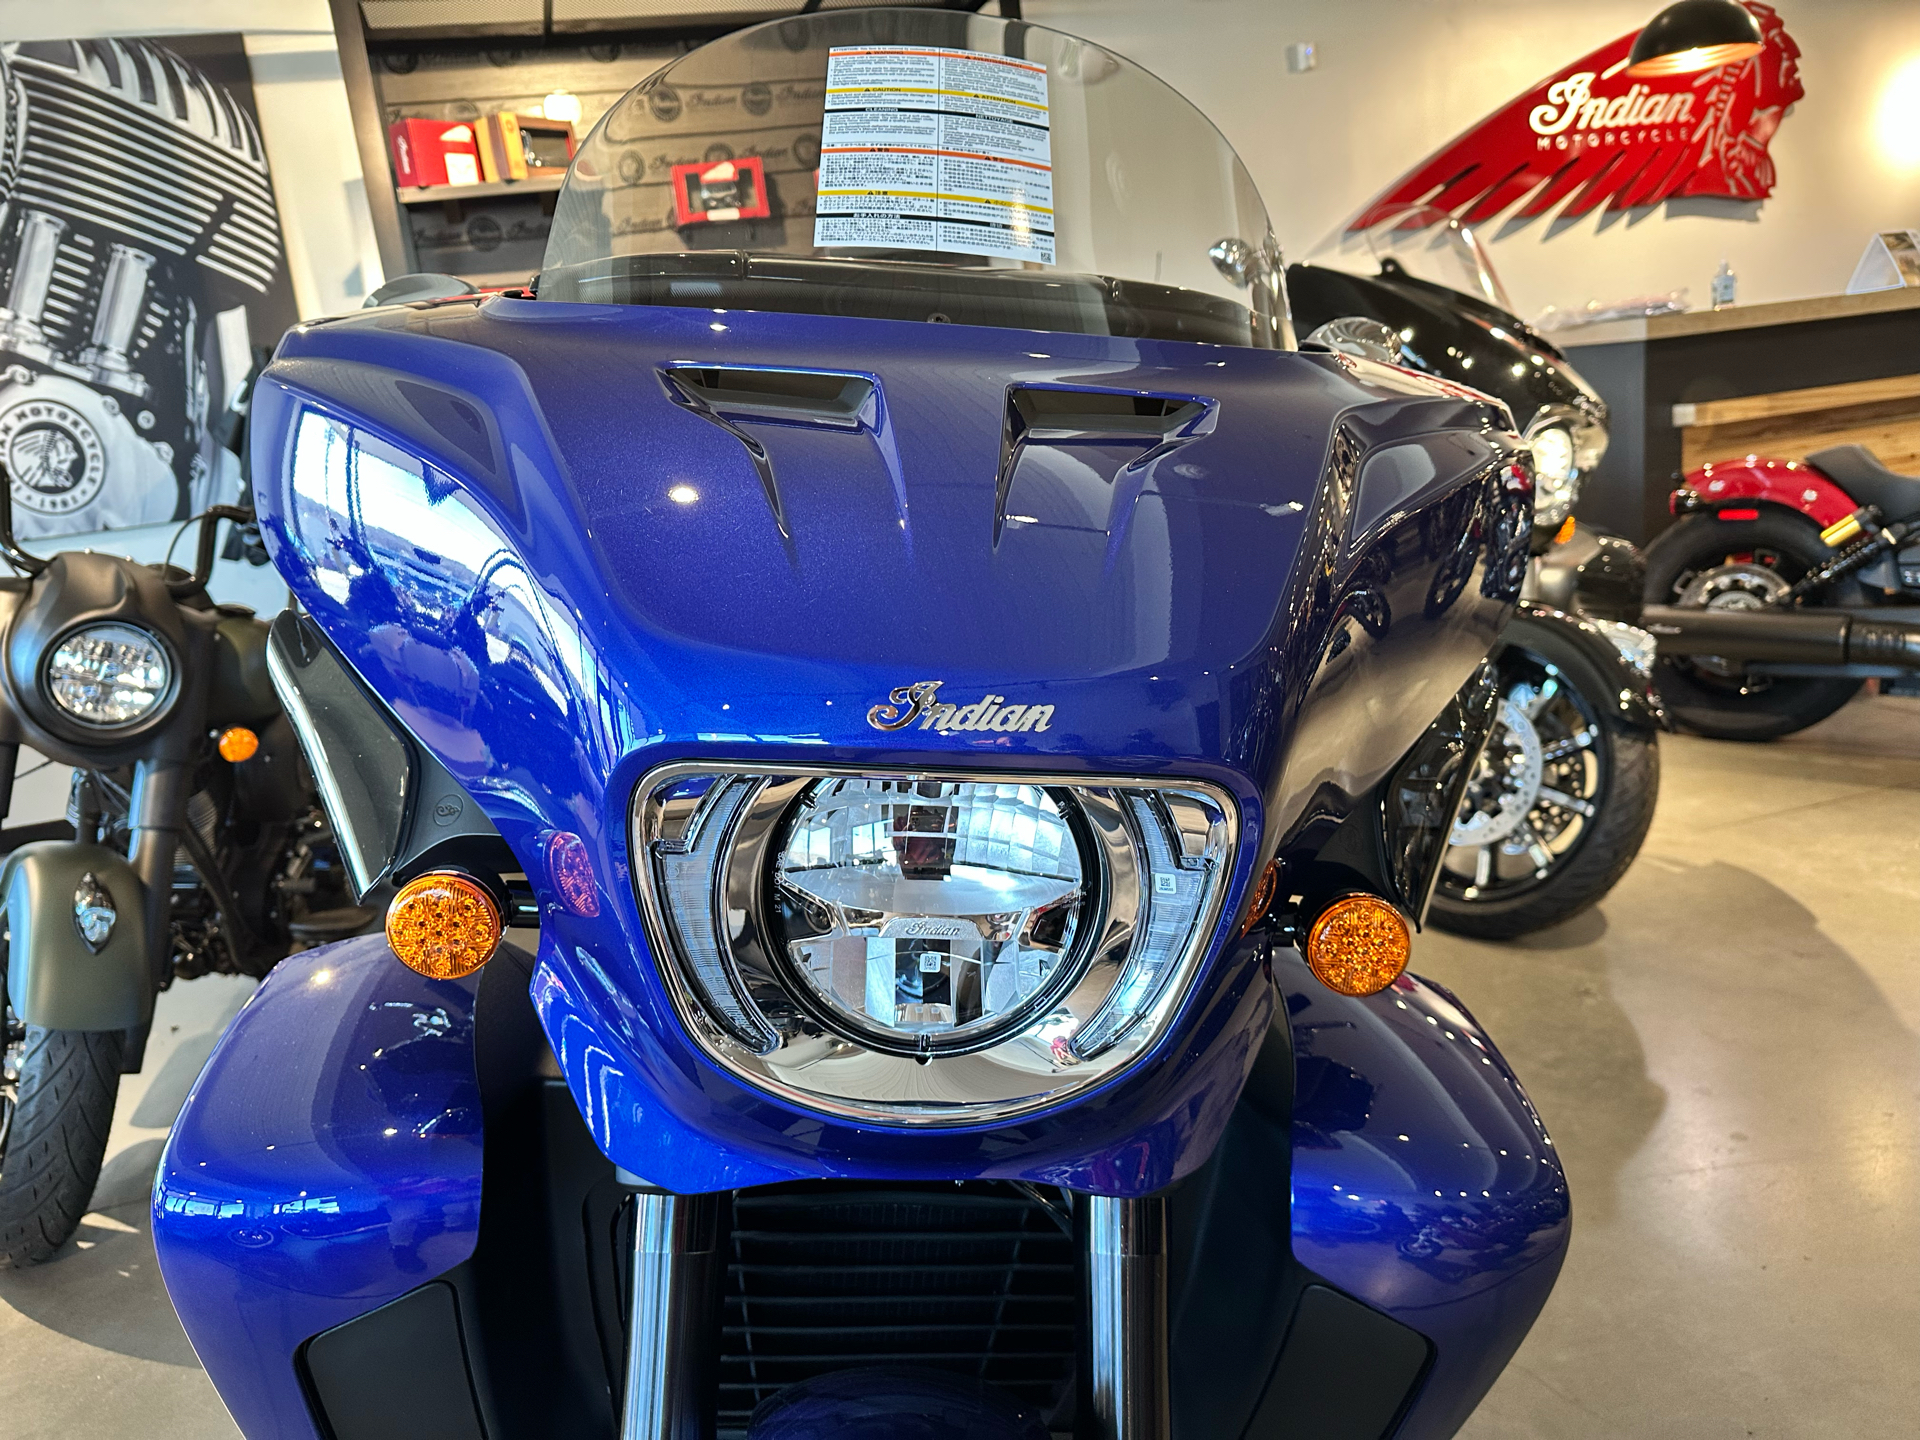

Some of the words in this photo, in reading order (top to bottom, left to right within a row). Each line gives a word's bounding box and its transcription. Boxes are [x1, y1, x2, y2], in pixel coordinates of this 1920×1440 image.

[981, 95, 1016, 104] ATTENTION
[1529, 72, 1695, 135] Indian
[1537, 127, 1689, 151] MOTORCYCLE
[14, 405, 101, 487] MOTORCYCLE
[866, 680, 1056, 733] Indian
[905, 921, 960, 936] Indian
